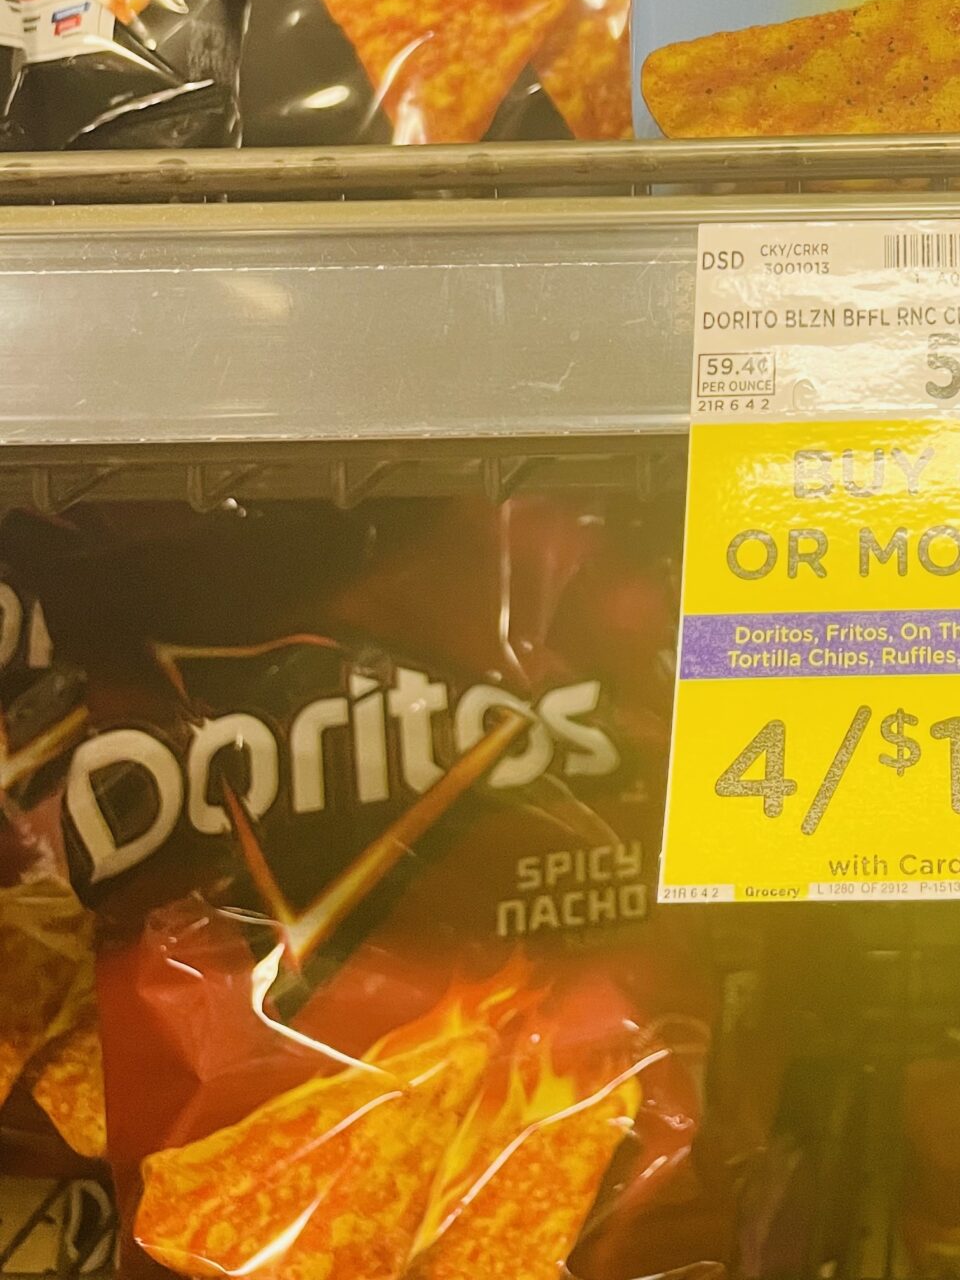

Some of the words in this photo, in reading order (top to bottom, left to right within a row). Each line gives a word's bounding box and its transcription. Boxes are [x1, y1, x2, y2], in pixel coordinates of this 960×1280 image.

[702, 251, 745, 270] DSD
[760, 243, 829, 258] CKY/CRKR
[703, 310, 778, 330] DORITO
[785, 309, 835, 328] BLZN
[843, 308, 890, 327] BFFL
[897, 307, 937, 326] RNC
[702, 381, 726, 393] PER
[729, 380, 772, 392] OUNCE
[698, 400, 724, 412] 21R
[730, 399, 739, 411] 6
[745, 398, 755, 410] 4
[760, 398, 770, 410] 2
[792, 447, 936, 500] BUY
[726, 528, 829, 581] OR
[735, 624, 820, 646] Doritos,
[825, 622, 894, 644] Fritos,
[900, 622, 931, 641] On
[728, 649, 801, 669] Tortilla
[809, 647, 875, 669] Chips,
[64, 666, 620, 885] Doritos
[517, 840, 642, 891] SPICY
[828, 854, 889, 876] with
[663, 888, 687, 899] 21R
[745, 886, 800, 899] Grocery
[829, 883, 855, 894] 1280
[861, 883, 878, 894] OF
[881, 883, 908, 894] 2912
[497, 883, 648, 937] NACHO
